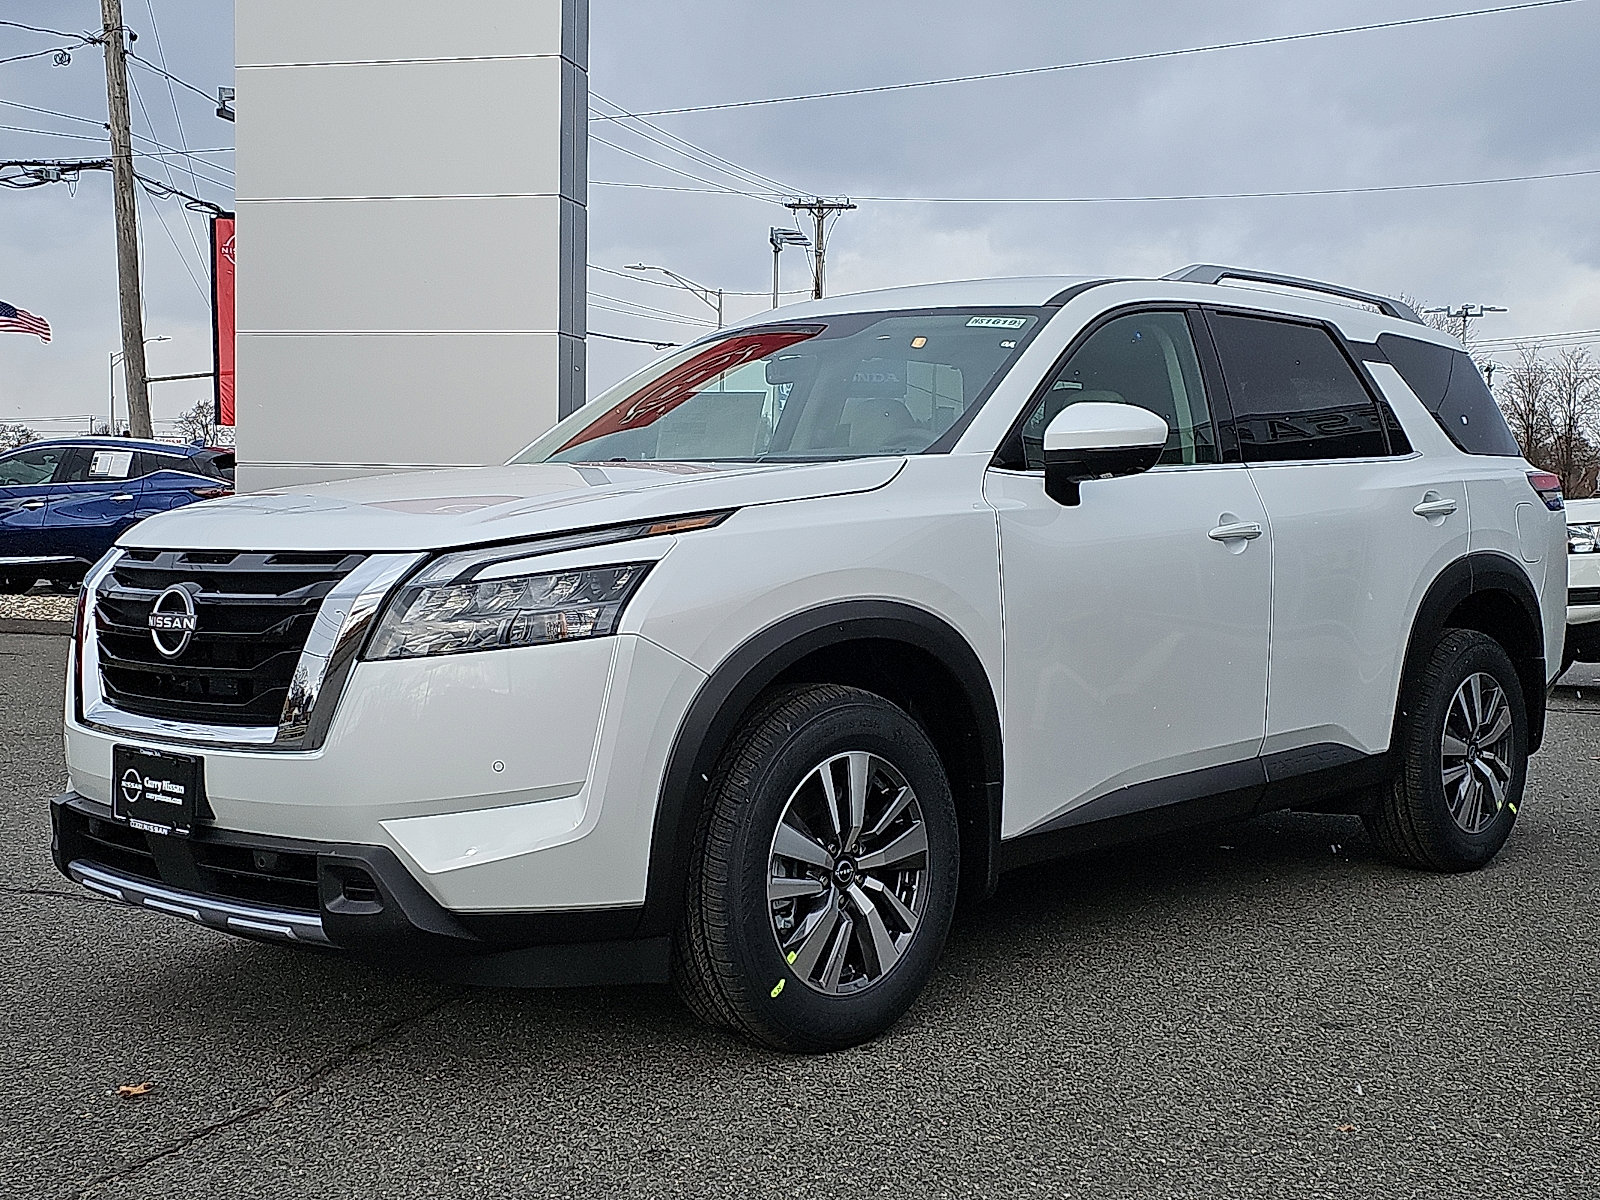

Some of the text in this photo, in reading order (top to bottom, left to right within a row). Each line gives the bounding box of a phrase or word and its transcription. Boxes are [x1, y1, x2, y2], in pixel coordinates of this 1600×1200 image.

[148, 615, 194, 630] NISSAN
[144, 777, 184, 794] Curry Nissan
